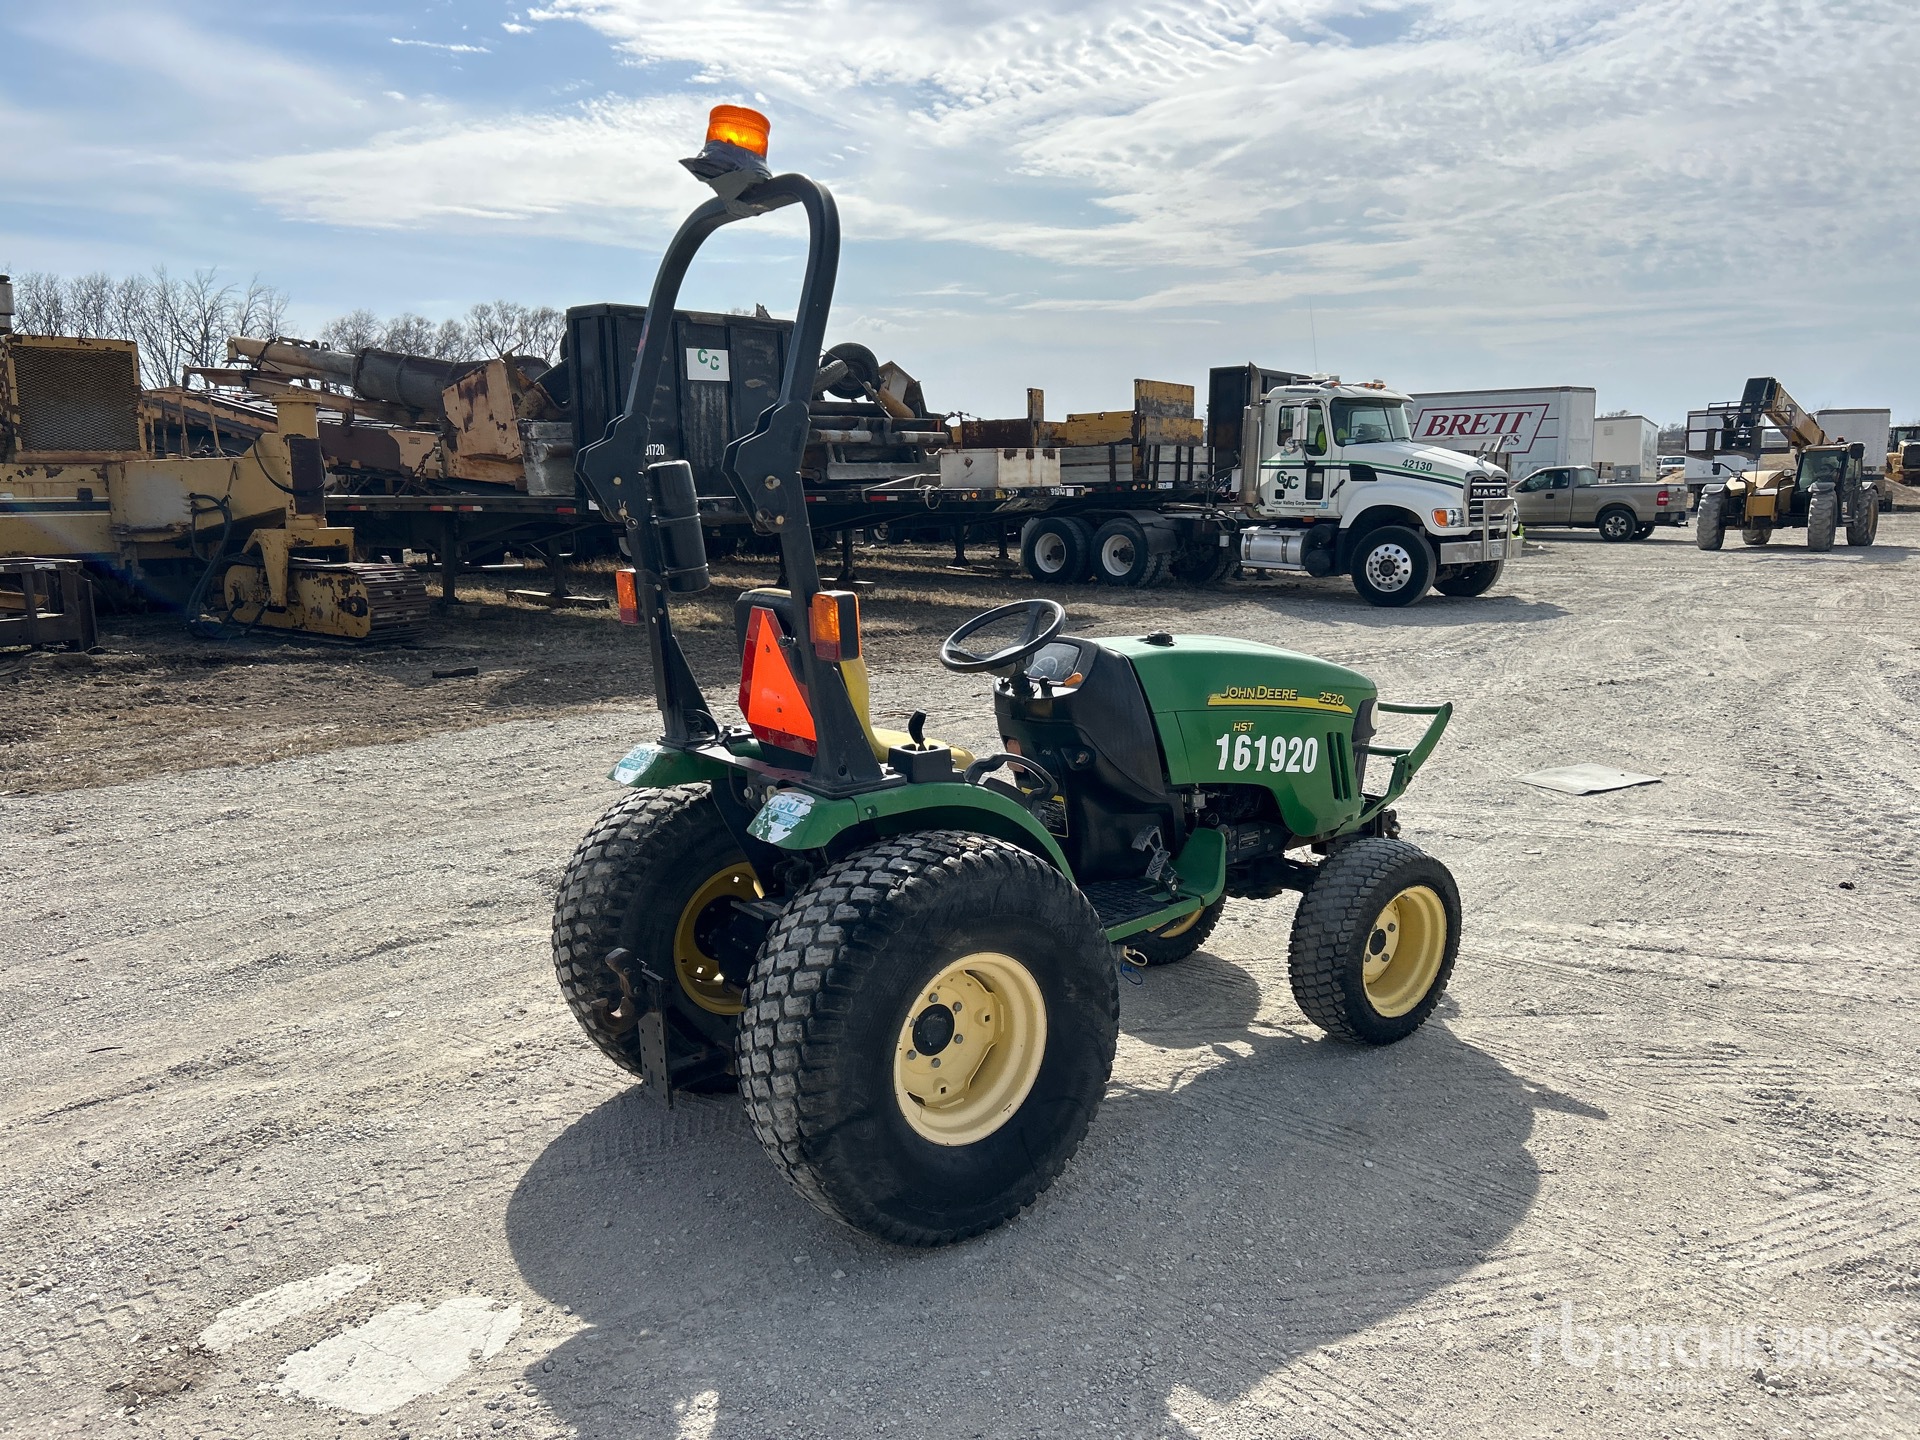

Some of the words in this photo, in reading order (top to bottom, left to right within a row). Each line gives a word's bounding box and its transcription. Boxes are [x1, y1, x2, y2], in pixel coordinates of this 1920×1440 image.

[1424, 412, 1532, 436] BRETT
[1402, 459, 1433, 472] 42130
[1472, 488, 1505, 497] MACK
[1221, 685, 1255, 699] JOHN
[1256, 685, 1298, 700] DEERE
[1318, 691, 1345, 705] 2520
[1233, 722, 1254, 732] HST
[1216, 733, 1319, 774] 161920
